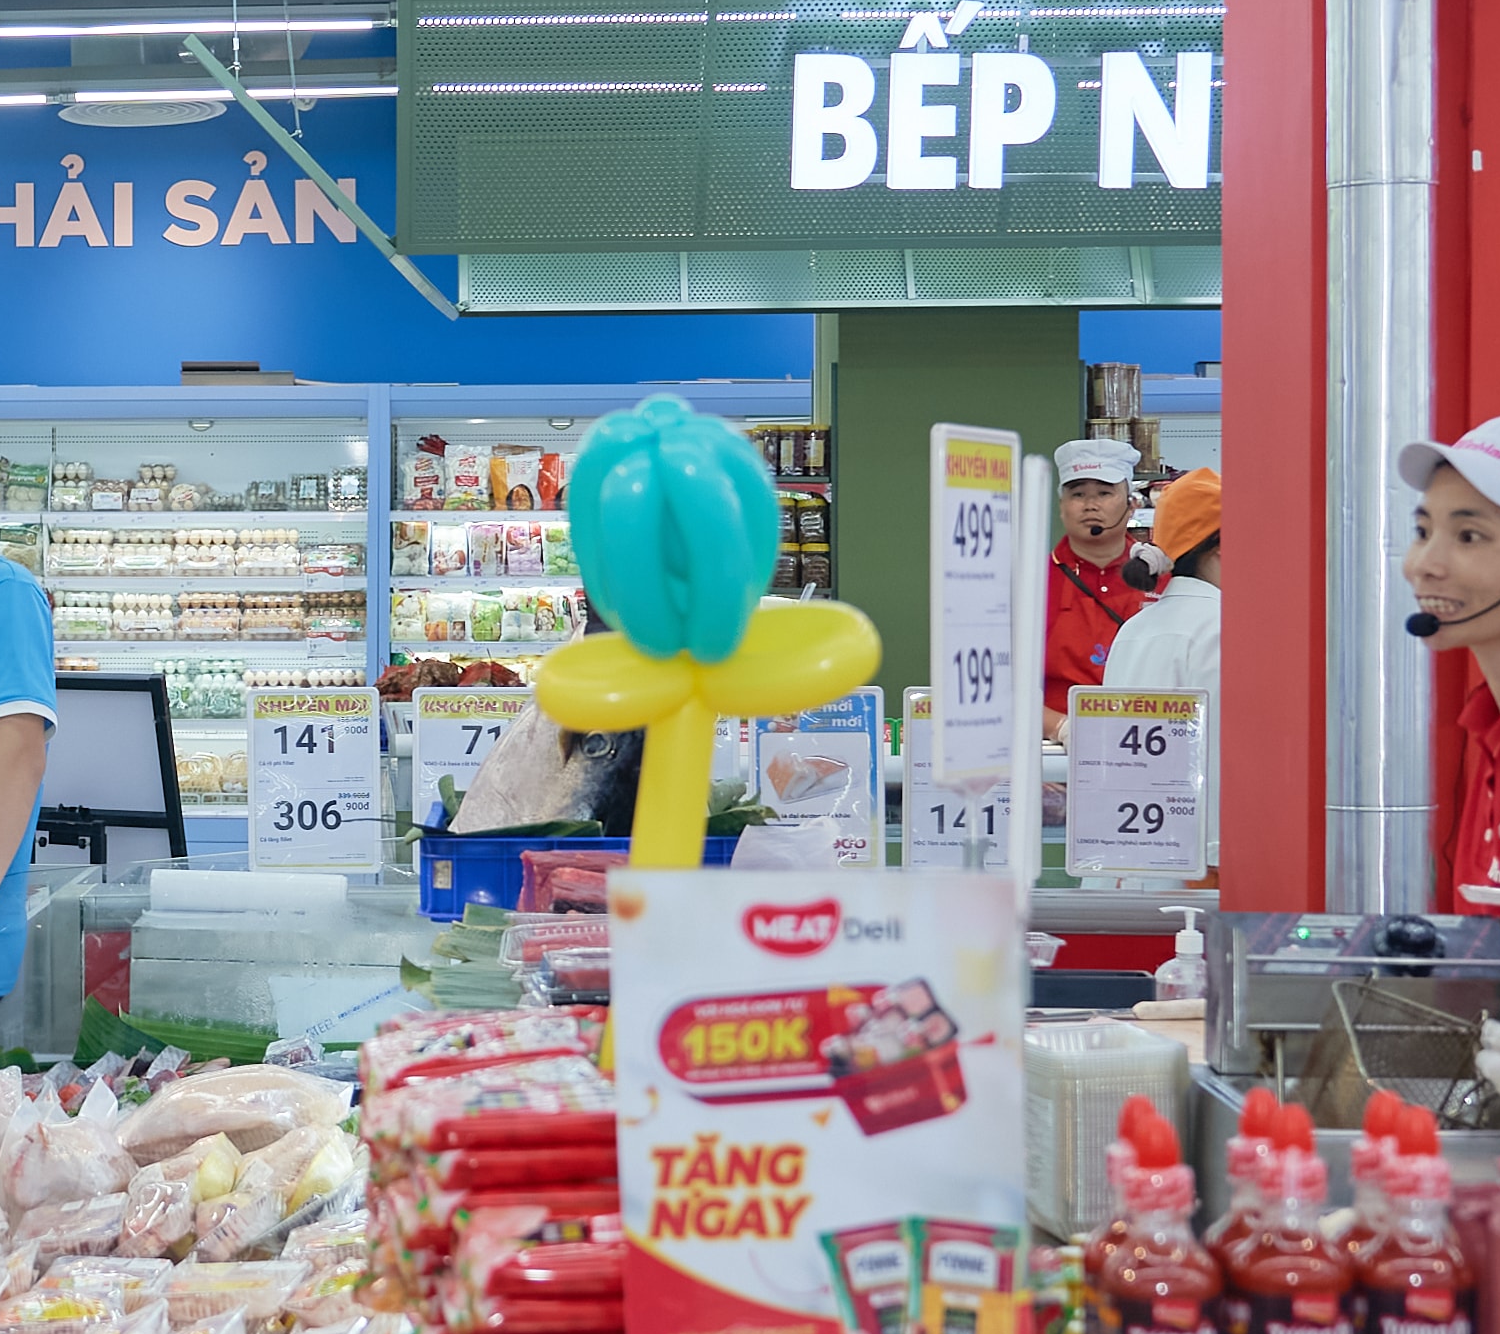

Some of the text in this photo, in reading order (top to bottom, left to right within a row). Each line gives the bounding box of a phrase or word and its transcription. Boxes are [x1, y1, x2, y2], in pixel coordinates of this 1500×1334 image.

[164, 150, 359, 245] SẢN
[945, 448, 987, 477] KHUYẾN
[953, 502, 993, 558] 499
[953, 647, 993, 705] 199
[258, 696, 367, 714] KHUYẾN MẠI
[424, 697, 497, 713] KHUYẾN
[823, 699, 853, 712] mới
[1080, 696, 1157, 713] KHUYẾN
[832, 716, 862, 728] mới
[274, 724, 335, 754] 141
[1119, 725, 1166, 756] 46
[273, 800, 370, 831] 306 .900đ
[1117, 802, 1195, 834] 29 .900đ
[752, 914, 902, 941] MEAT Deli
[682, 1017, 808, 1065] 150K
[650, 1196, 811, 1239] NGAY
